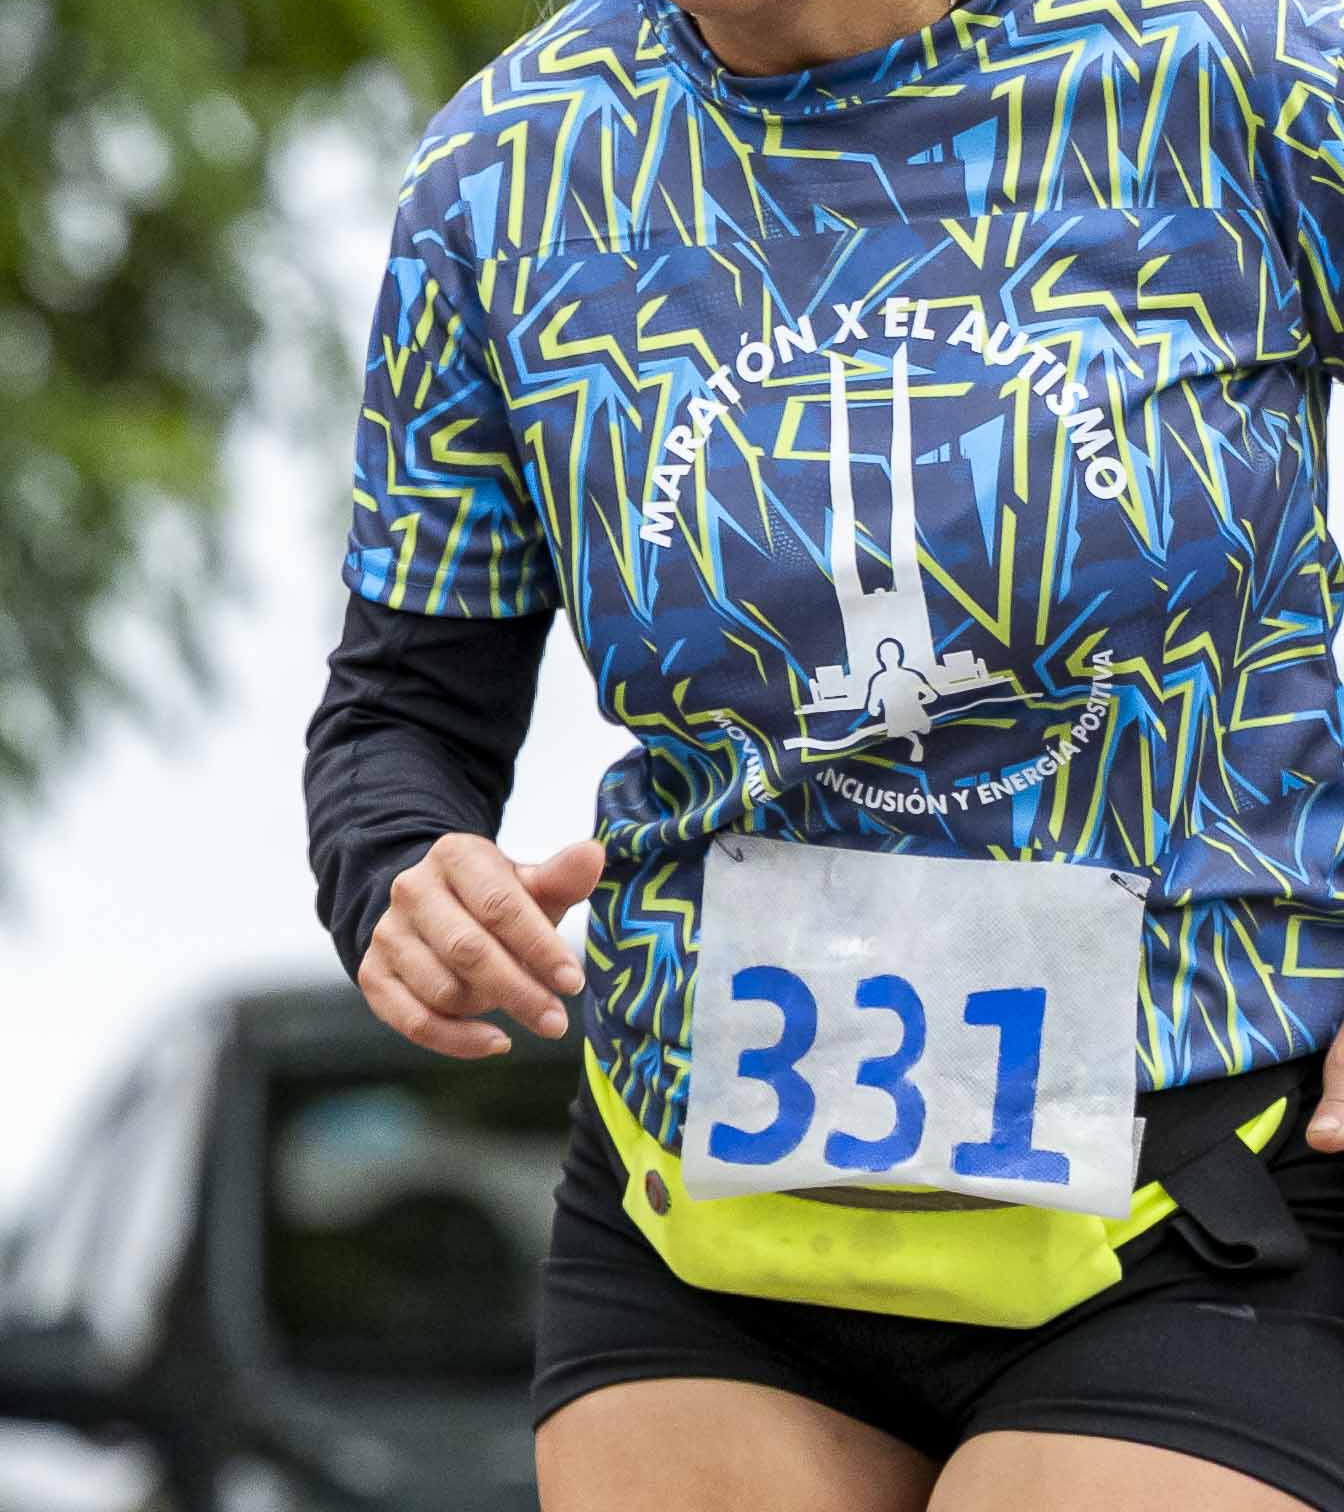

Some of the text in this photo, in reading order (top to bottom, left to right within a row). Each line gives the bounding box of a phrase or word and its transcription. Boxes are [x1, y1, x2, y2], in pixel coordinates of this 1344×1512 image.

[640, 297, 1127, 549] MARATÓN X EL AUTISMO
[952, 788, 970, 811] Y
[977, 739, 1082, 806] ENERGÍA
[1071, 649, 1114, 743] POSITIVA
[708, 964, 1070, 1186] 331
